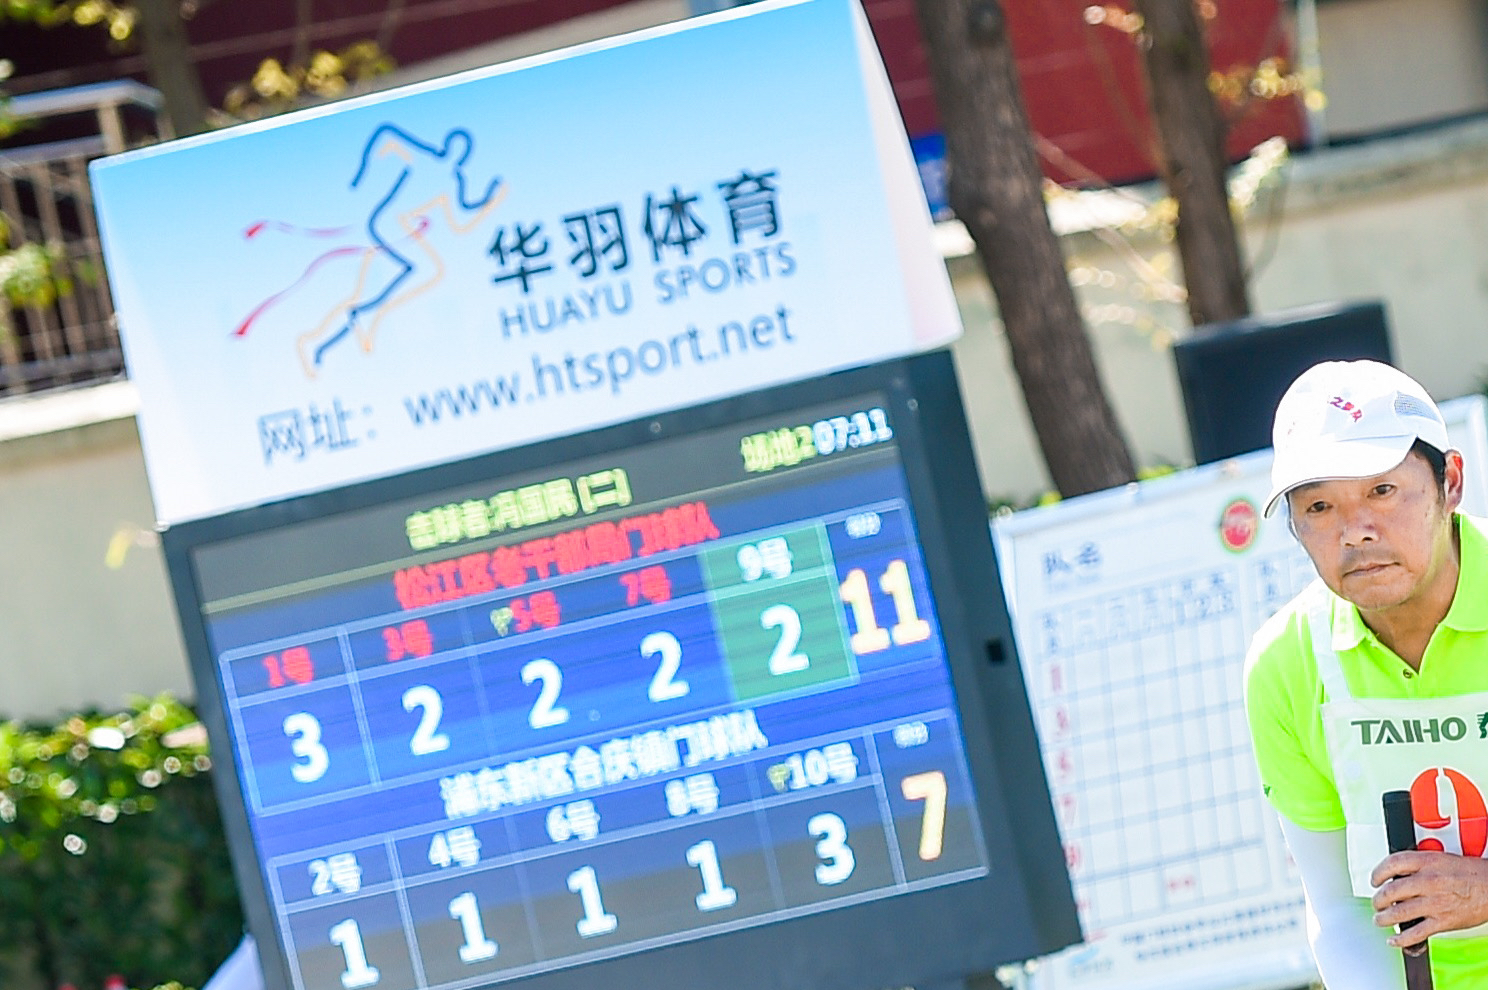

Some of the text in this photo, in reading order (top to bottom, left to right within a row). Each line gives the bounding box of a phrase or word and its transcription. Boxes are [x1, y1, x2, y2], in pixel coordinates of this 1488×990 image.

[486, 167, 783, 294] 华羽体育
[500, 243, 797, 339] HUAYU SPORTS
[405, 304, 794, 428] www.htsport.net
[736, 536, 794, 582] 9号
[281, 559, 932, 784] 3 2 2 2 2 11
[1350, 717, 1467, 746] TAIHO
[307, 852, 362, 897] 2号
[428, 825, 481, 868] 4号
[546, 799, 601, 843] 6号
[788, 741, 859, 791] 10号
[1410, 766, 1488, 858] 9
[329, 771, 948, 990] 1 1 1 1 3 7
